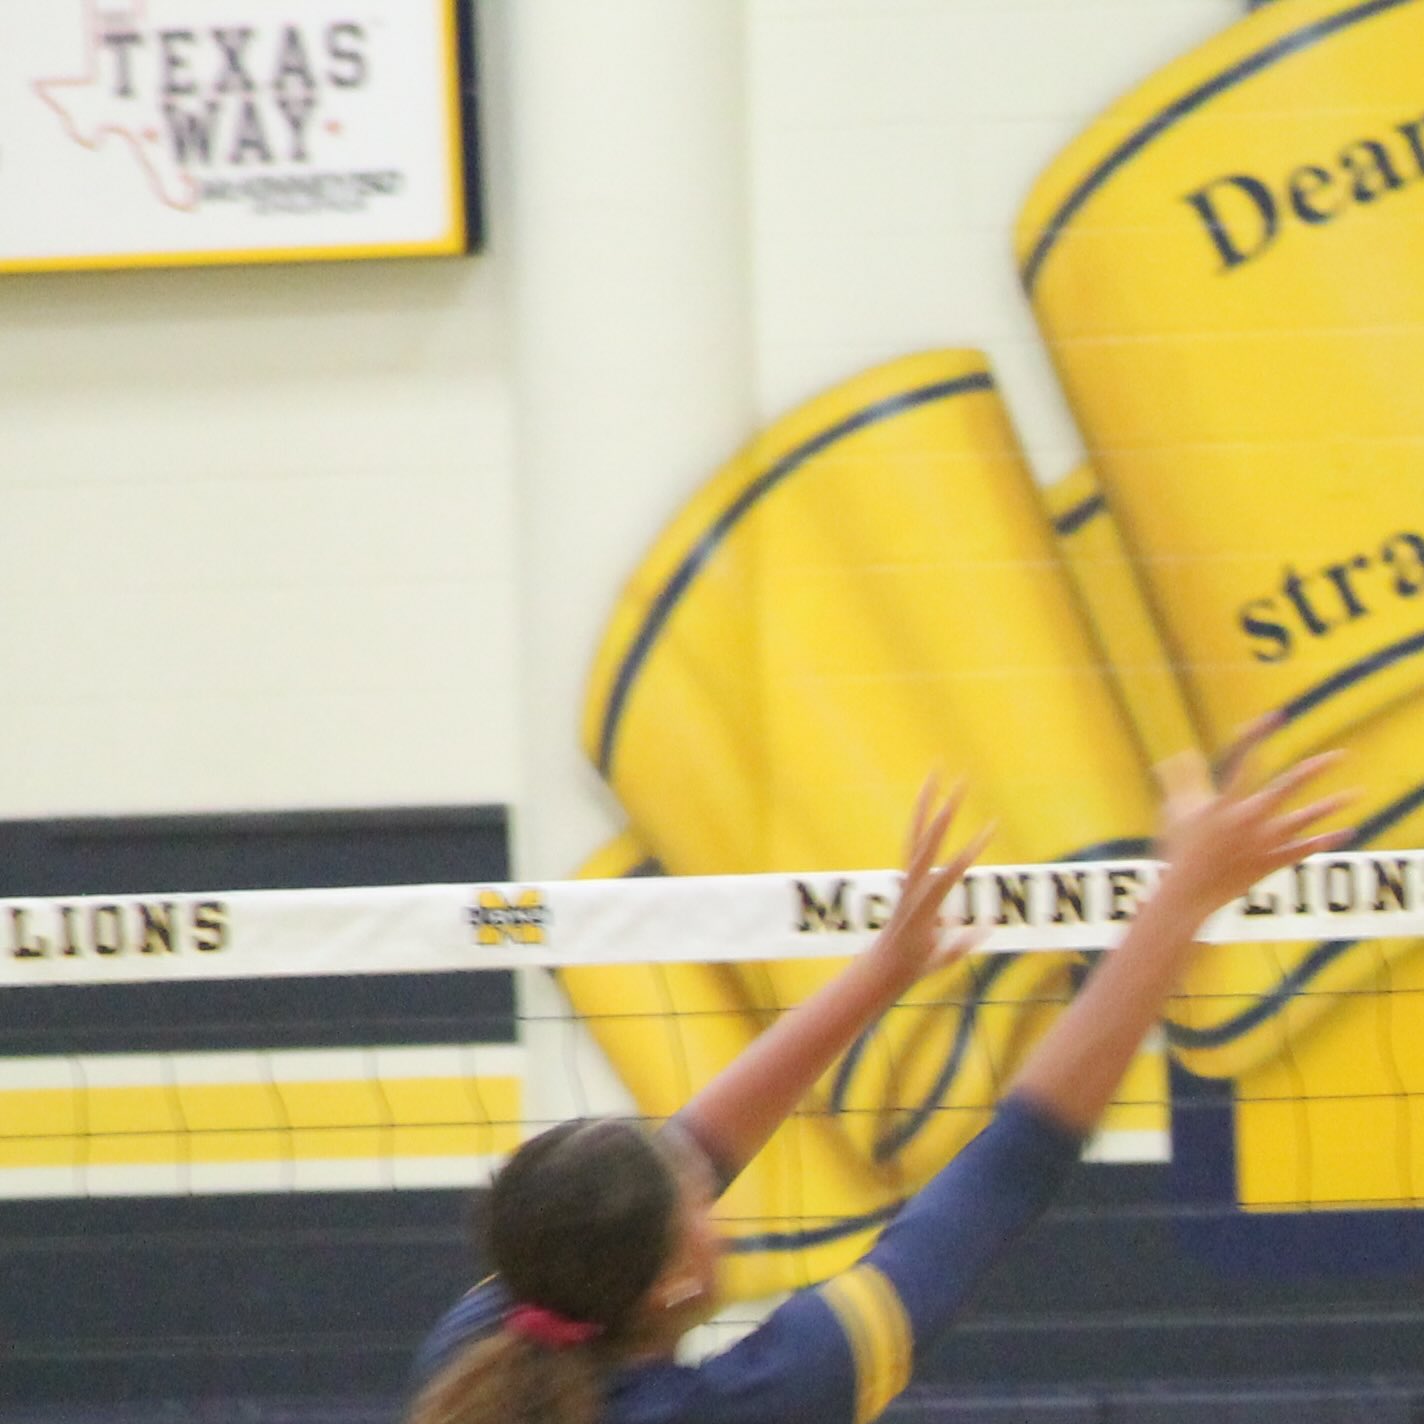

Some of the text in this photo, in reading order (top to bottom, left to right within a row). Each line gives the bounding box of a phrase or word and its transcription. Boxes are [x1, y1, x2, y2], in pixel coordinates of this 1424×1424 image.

[102, 20, 369, 99] TEXAS
[162, 98, 319, 165] WAY
[9, 901, 230, 958] LIONS
